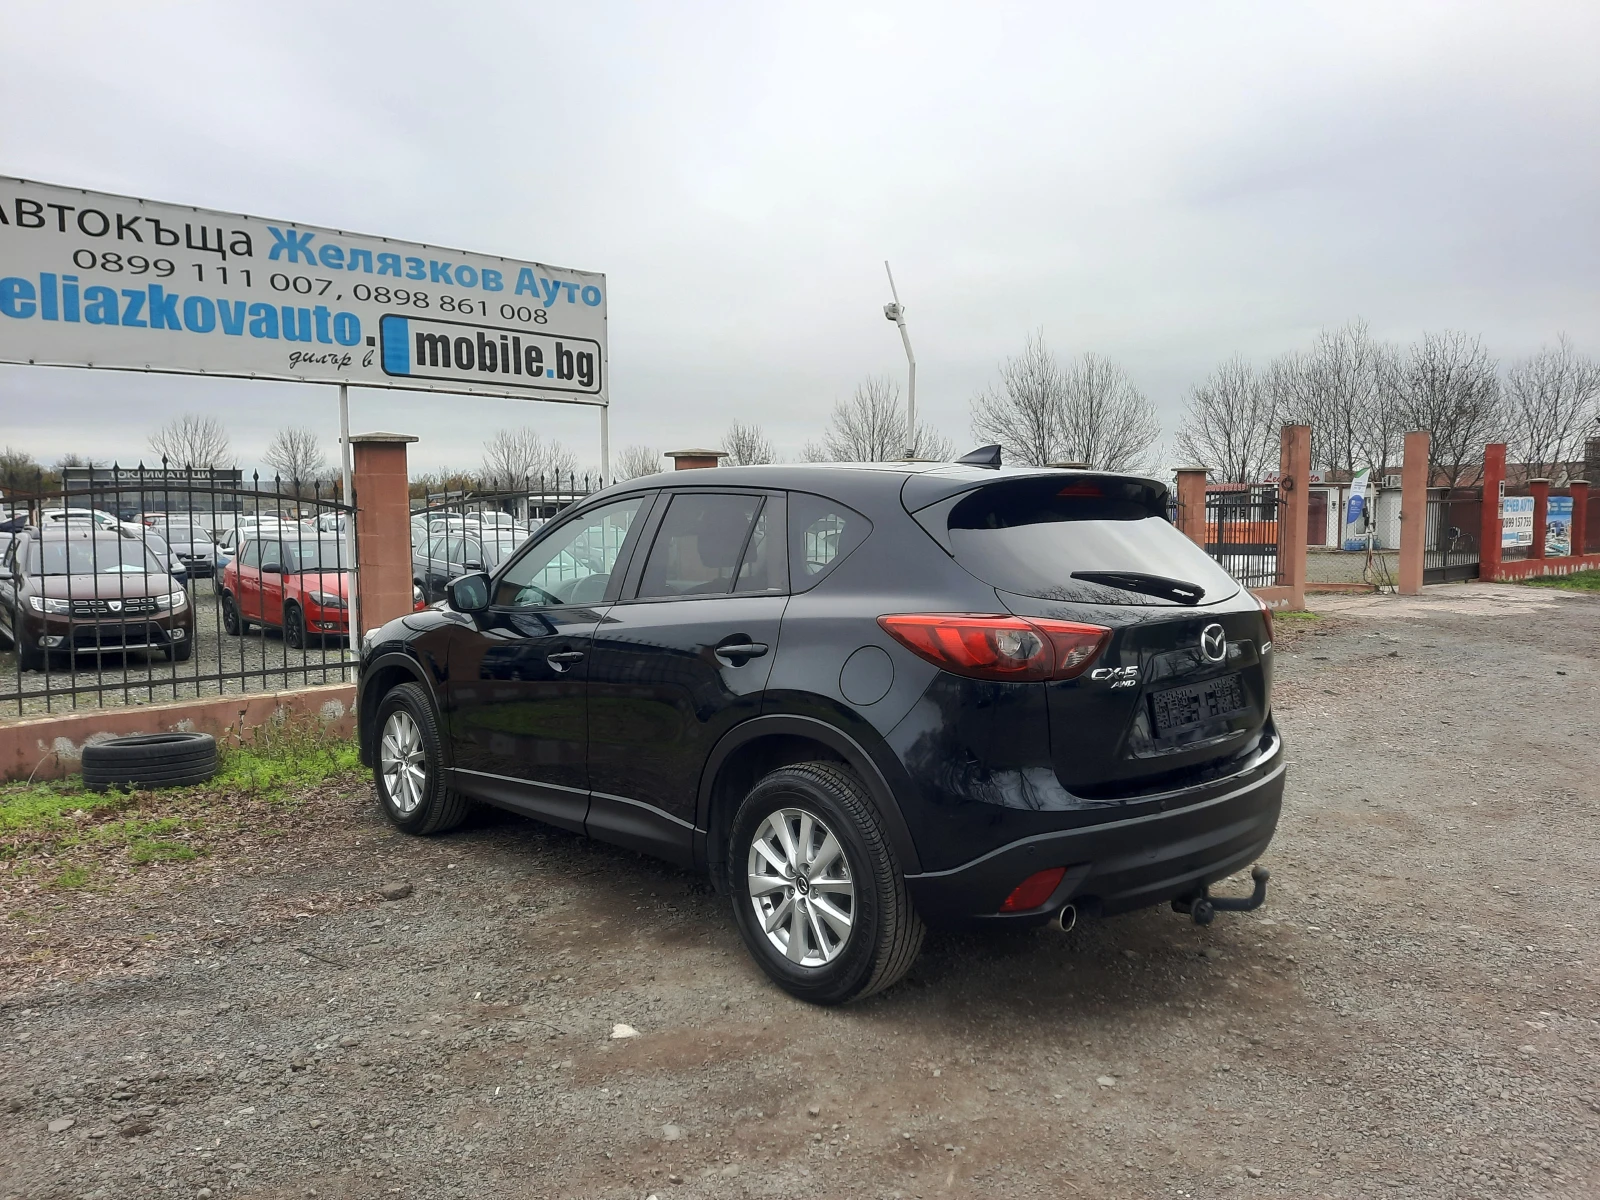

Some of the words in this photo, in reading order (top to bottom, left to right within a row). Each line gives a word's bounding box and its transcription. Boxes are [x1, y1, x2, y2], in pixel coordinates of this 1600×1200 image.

[73, 249, 176, 277] 0899
[192, 263, 252, 288] 111
[270, 273, 343, 301] 007,
[353, 284, 430, 309] 0898
[439, 295, 487, 316] 861
[500, 303, 548, 324] 008
[267, 226, 504, 292] Желязков
[514, 267, 602, 308] Ауто
[415, 331, 594, 387] mobile.bg
[1091, 665, 1139, 681] CX-5
[1110, 679, 1136, 689] AWD
